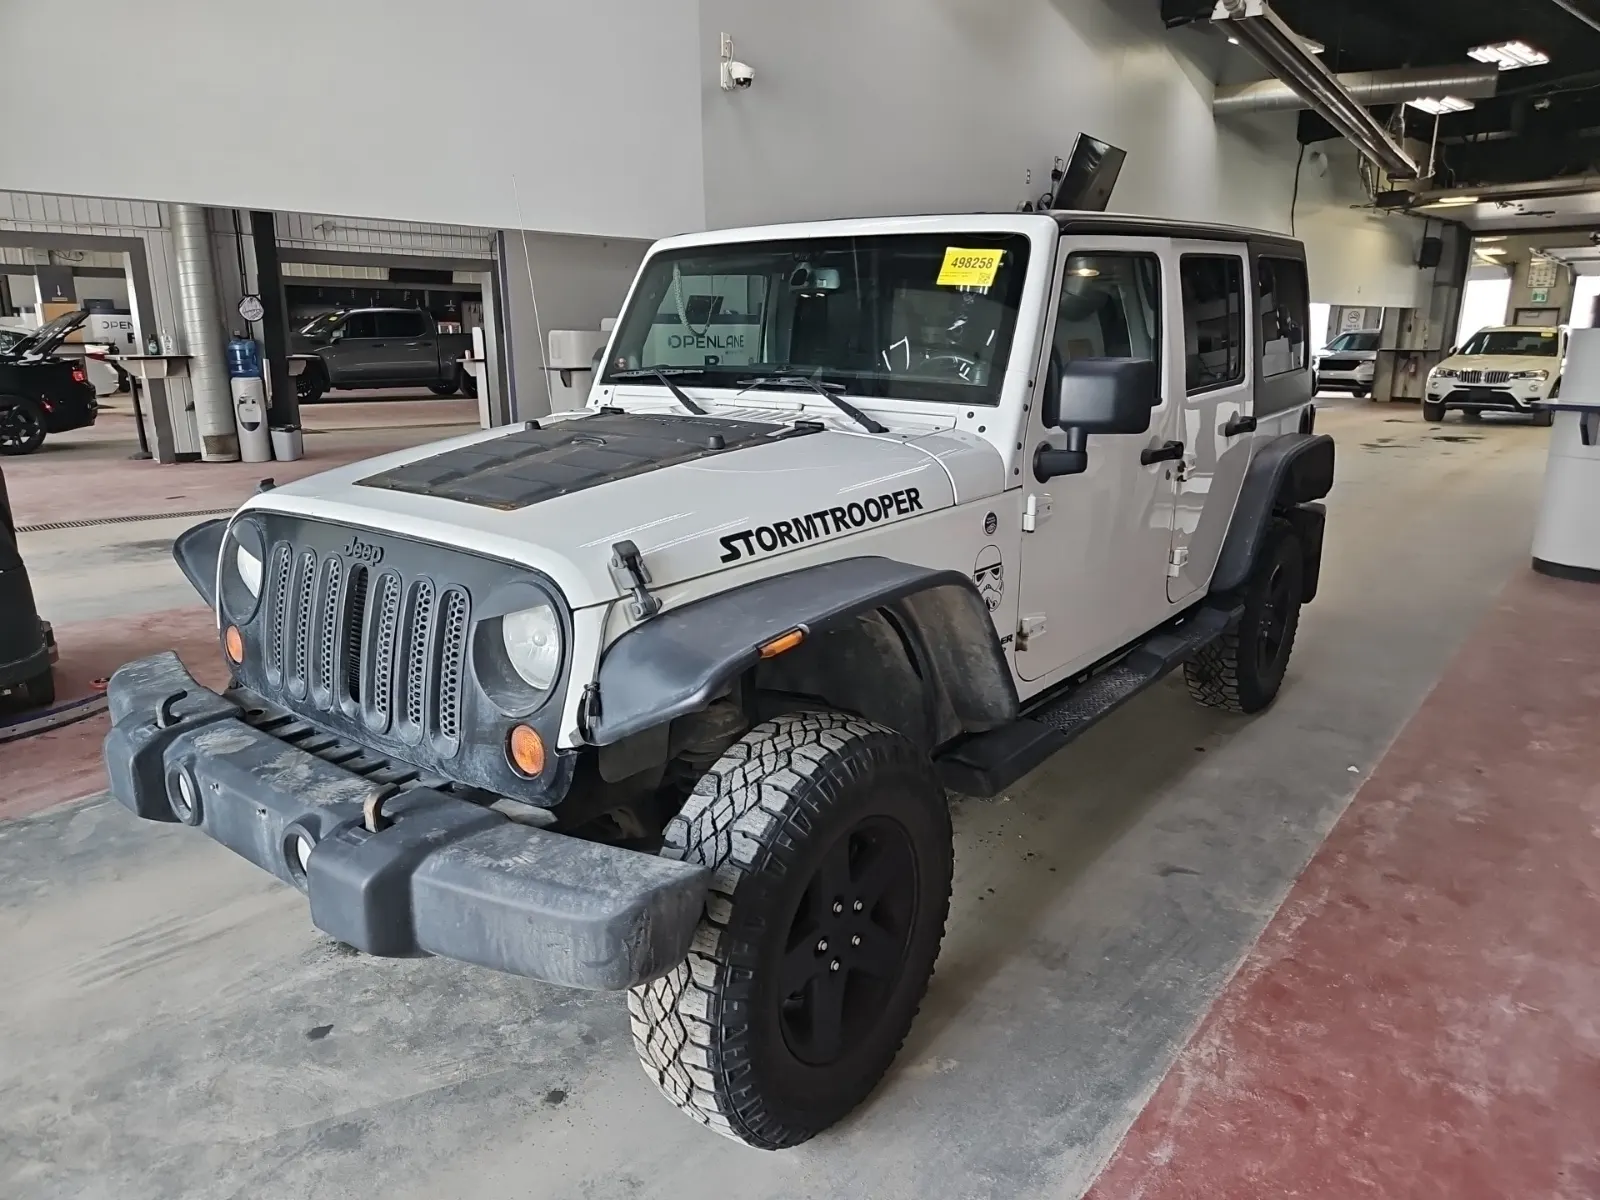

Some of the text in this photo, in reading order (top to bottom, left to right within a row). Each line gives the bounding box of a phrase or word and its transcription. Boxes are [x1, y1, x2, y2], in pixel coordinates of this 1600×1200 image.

[951, 257, 994, 269] 498258
[668, 335, 744, 348] OPENLANE
[719, 487, 923, 563] STORMTROOPER
[344, 536, 384, 567] Jeep
